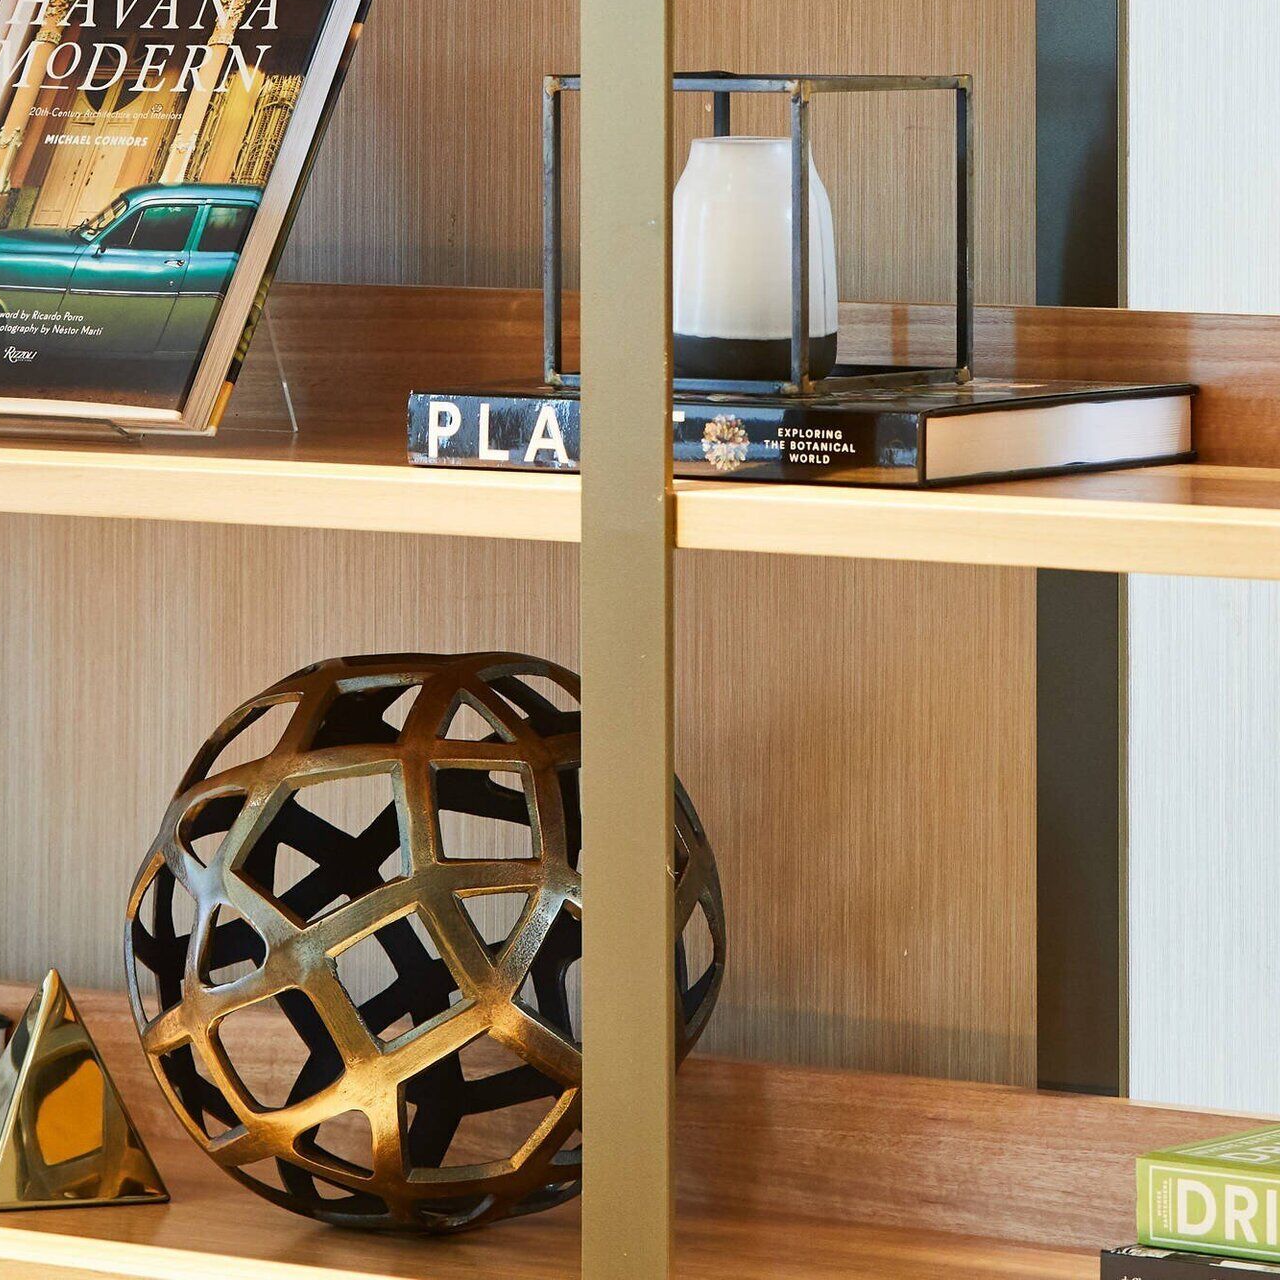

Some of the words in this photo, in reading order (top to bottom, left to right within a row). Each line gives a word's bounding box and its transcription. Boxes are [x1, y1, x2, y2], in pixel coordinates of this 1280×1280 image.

[132, 110, 149, 120] and
[44, 134, 91, 146] MICHAEL
[94, 135, 149, 147] CONNORS
[20, 310, 30, 321] by
[31, 310, 62, 321] Ricardo
[63, 311, 84, 322] Porro
[40, 323, 51, 335] by
[428, 401, 685, 464] PLA
[777, 428, 843, 440] EXPLORING
[763, 439, 786, 450] THE
[790, 441, 856, 453] BOTANICAL
[789, 453, 831, 464] WORLD
